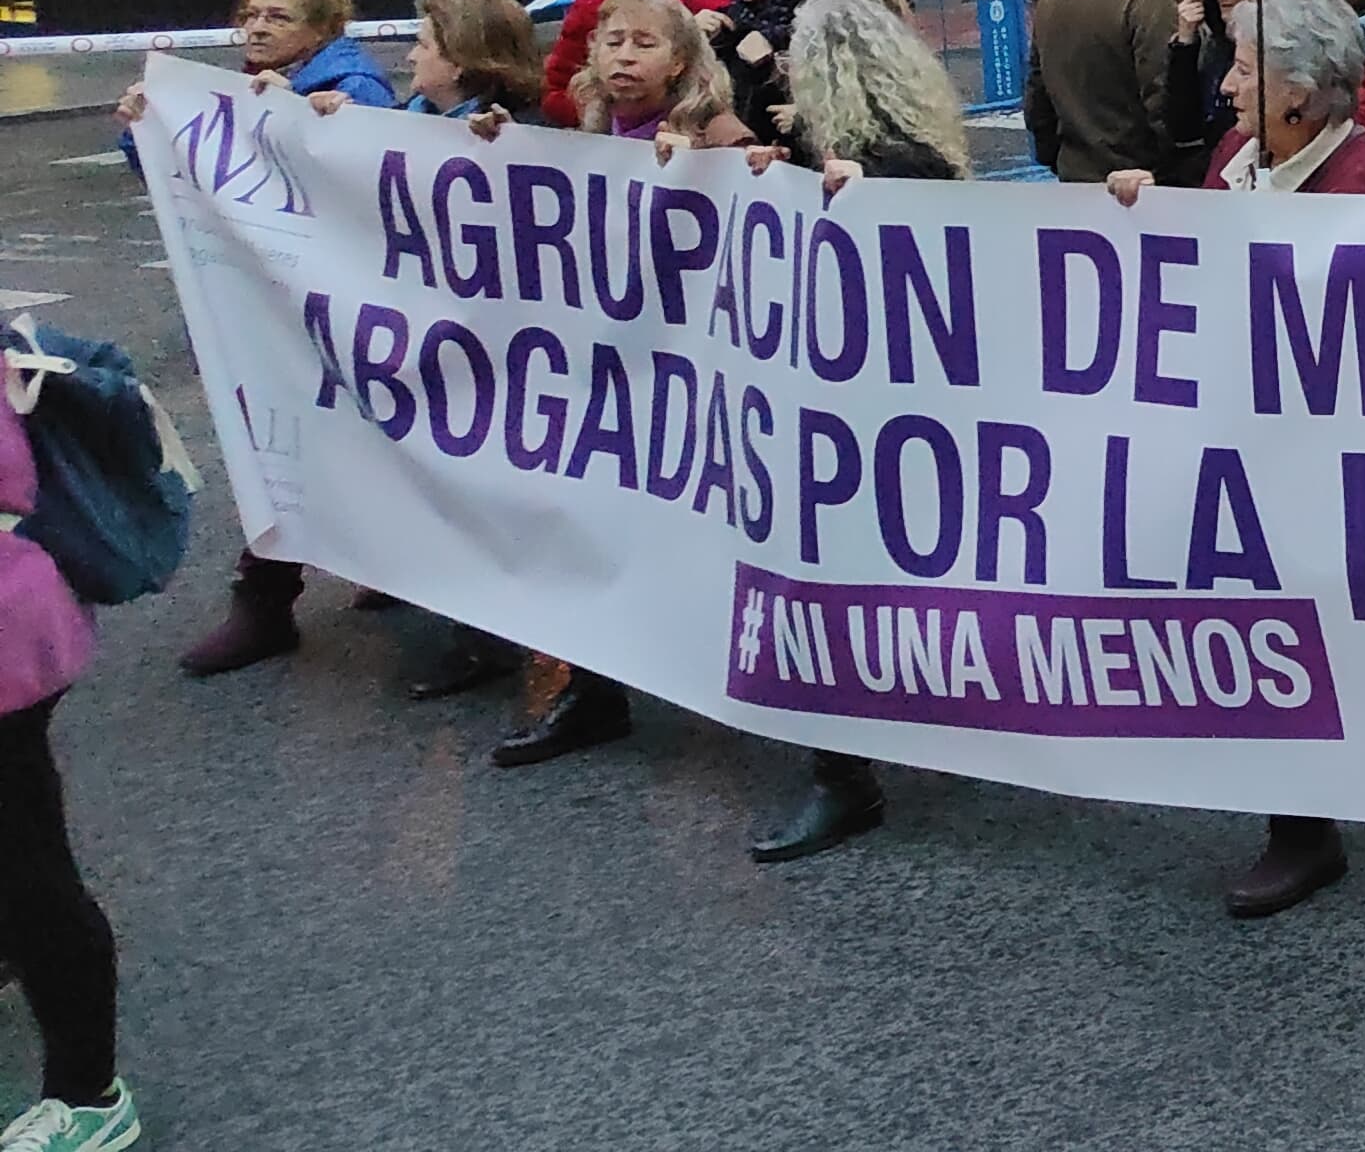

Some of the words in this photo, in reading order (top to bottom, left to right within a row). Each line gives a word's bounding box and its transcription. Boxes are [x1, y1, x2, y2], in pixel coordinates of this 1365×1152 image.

[379, 150, 982, 388] AGRUPACIÓN
[1036, 227, 1200, 409] DE
[303, 291, 775, 544] ABOGADAS
[800, 405, 1053, 587] POR
[1104, 435, 1283, 591] LA
[738, 587, 837, 687] #NI
[848, 605, 1001, 703] UNA
[1014, 614, 1313, 710] MENOS
